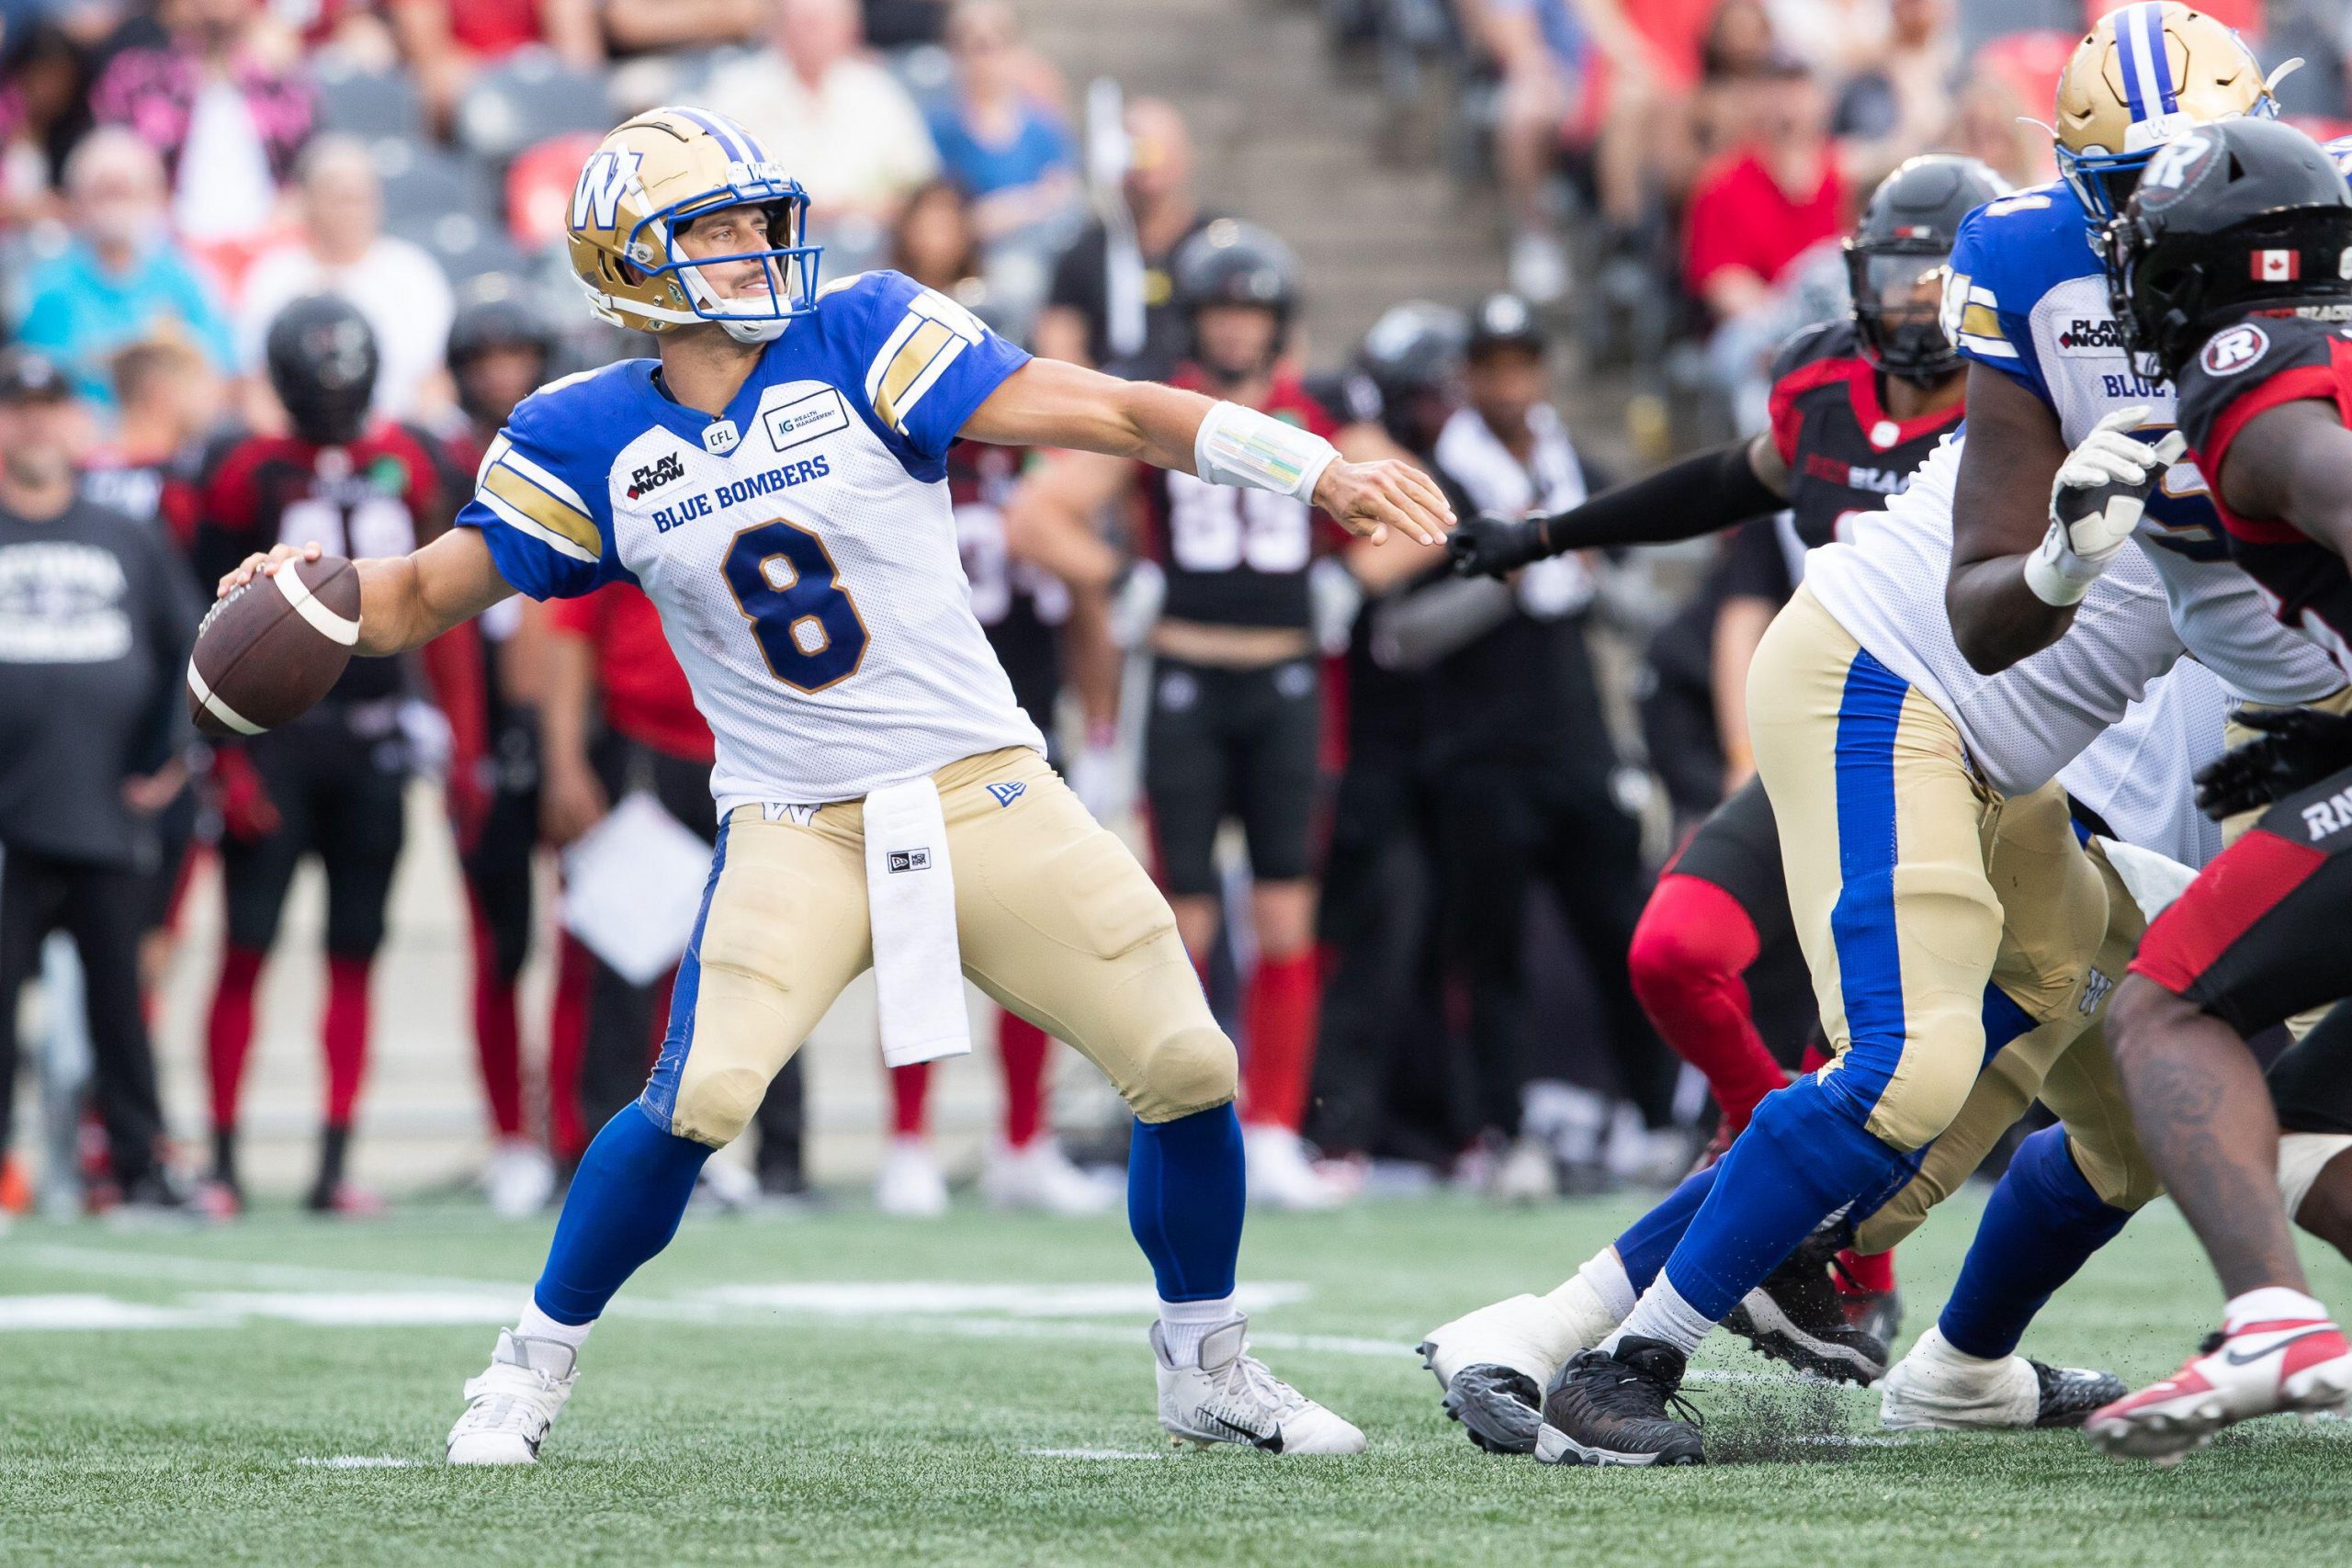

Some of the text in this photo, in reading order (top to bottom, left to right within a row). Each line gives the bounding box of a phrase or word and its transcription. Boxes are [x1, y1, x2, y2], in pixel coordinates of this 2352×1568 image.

[571, 151, 644, 231] W
[2214, 329, 2256, 369] R
[709, 429, 733, 447] CFL
[778, 419, 795, 434] IG
[631, 450, 678, 483] PLAY
[637, 462, 685, 495] NOW
[651, 454, 831, 535] BLUE BOMBERS
[718, 516, 871, 695] 8
